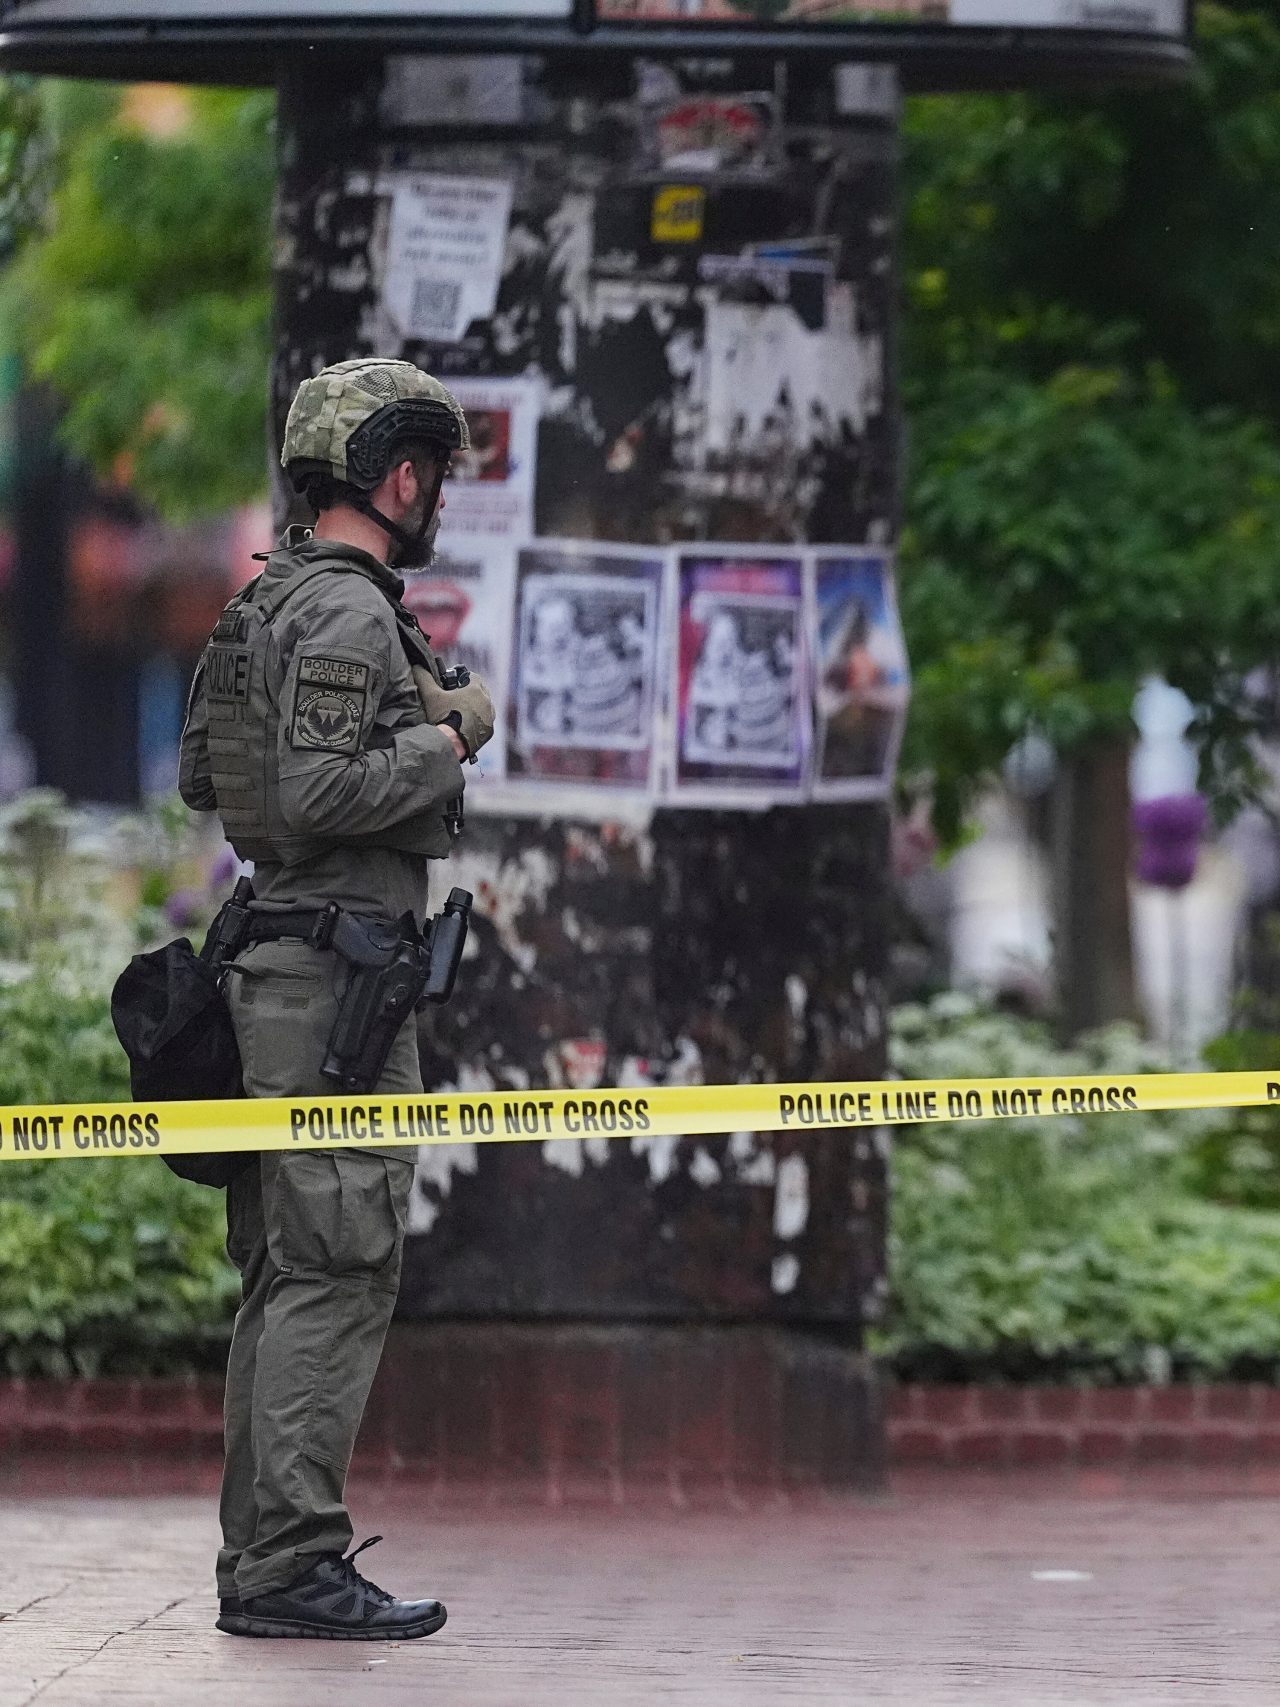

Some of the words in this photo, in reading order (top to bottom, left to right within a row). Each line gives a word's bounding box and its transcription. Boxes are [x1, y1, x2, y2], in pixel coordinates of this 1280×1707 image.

[304, 660, 363, 676] BOULDER
[311, 670, 355, 686] POLICE
[324, 690, 348, 705] POLICE
[780, 1093, 872, 1124] POLICE
[882, 1091, 938, 1121] LINE
[947, 1089, 981, 1118] DO
[992, 1088, 1042, 1116] NOT
[1052, 1086, 1138, 1114] CROSS
[13, 1116, 63, 1151] NOT
[73, 1113, 160, 1149] CROSS
[290, 1106, 384, 1141] POLICE
[393, 1104, 451, 1137] LINE
[460, 1102, 495, 1135] DO
[504, 1101, 554, 1134] NOT
[564, 1099, 651, 1133] CROSS
